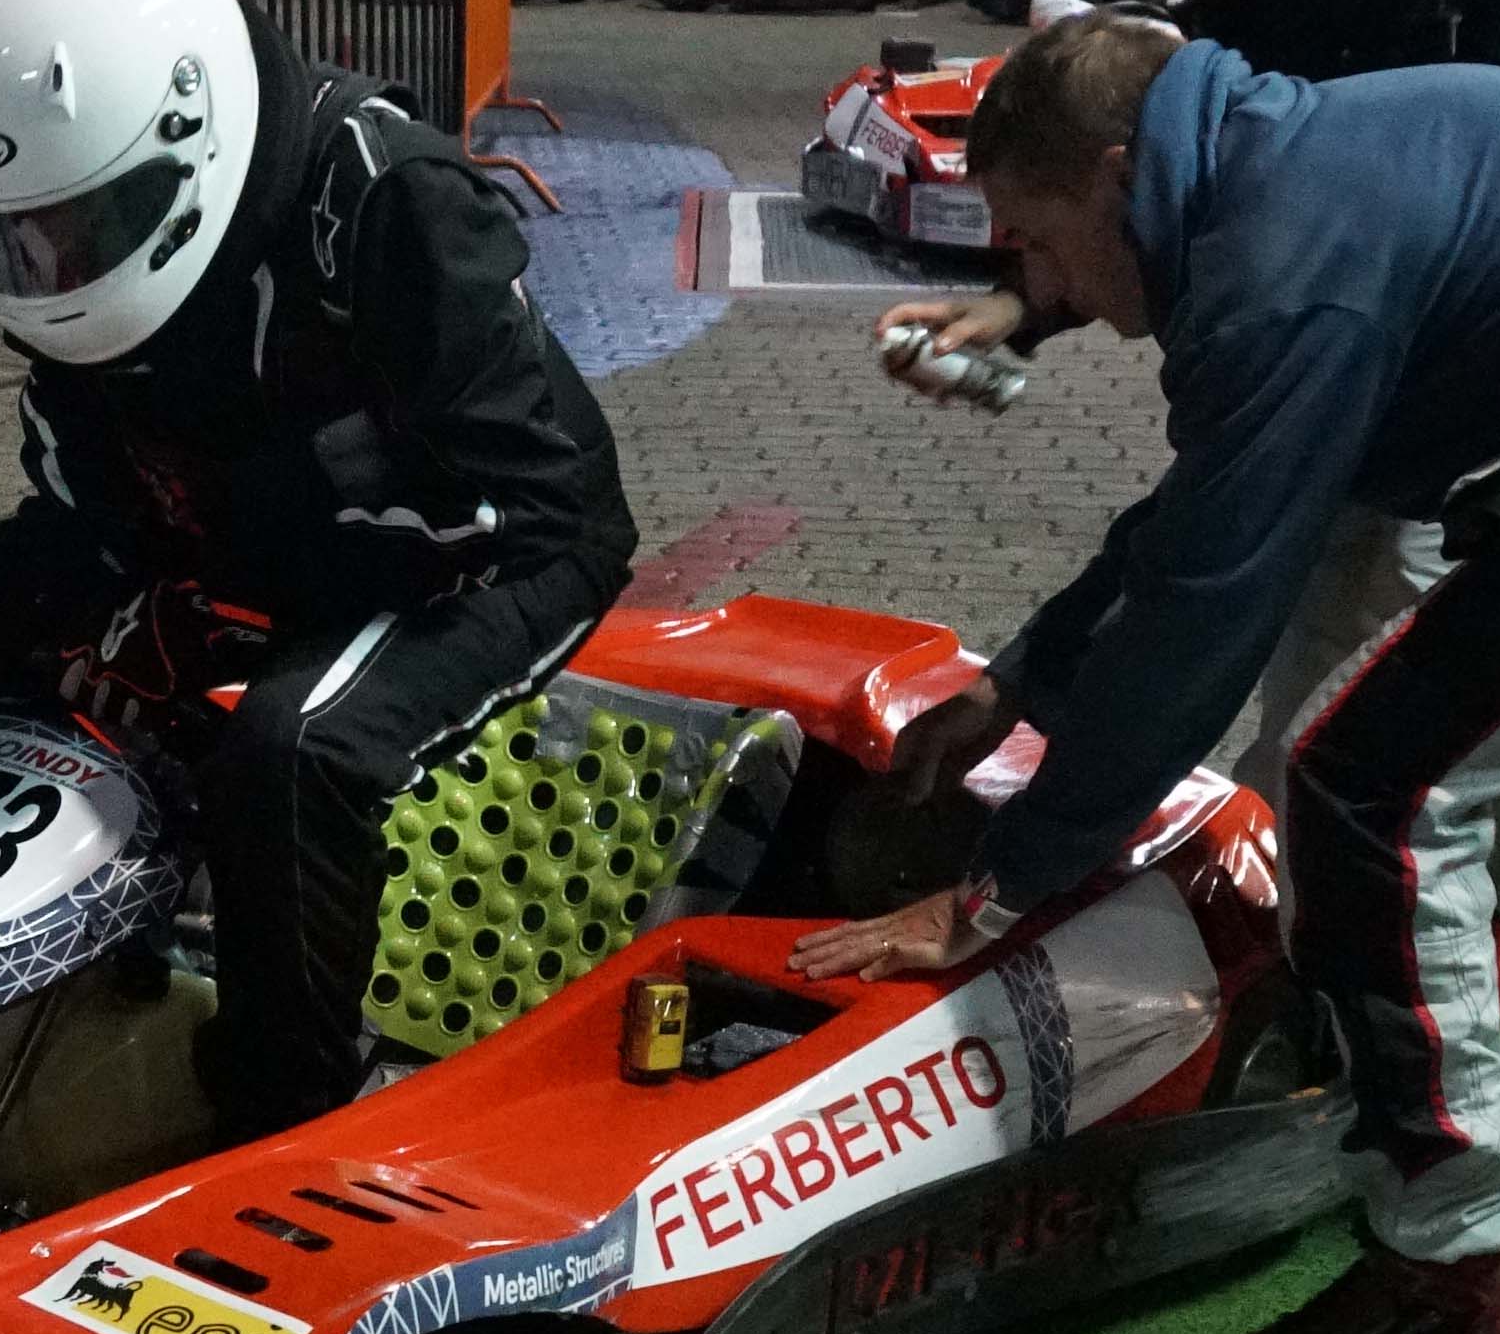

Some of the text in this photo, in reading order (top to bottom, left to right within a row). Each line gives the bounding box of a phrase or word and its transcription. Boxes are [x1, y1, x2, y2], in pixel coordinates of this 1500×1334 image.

[650, 1034, 1006, 1270] FERBERTO
[483, 1238, 626, 1308] Metallic Structures
